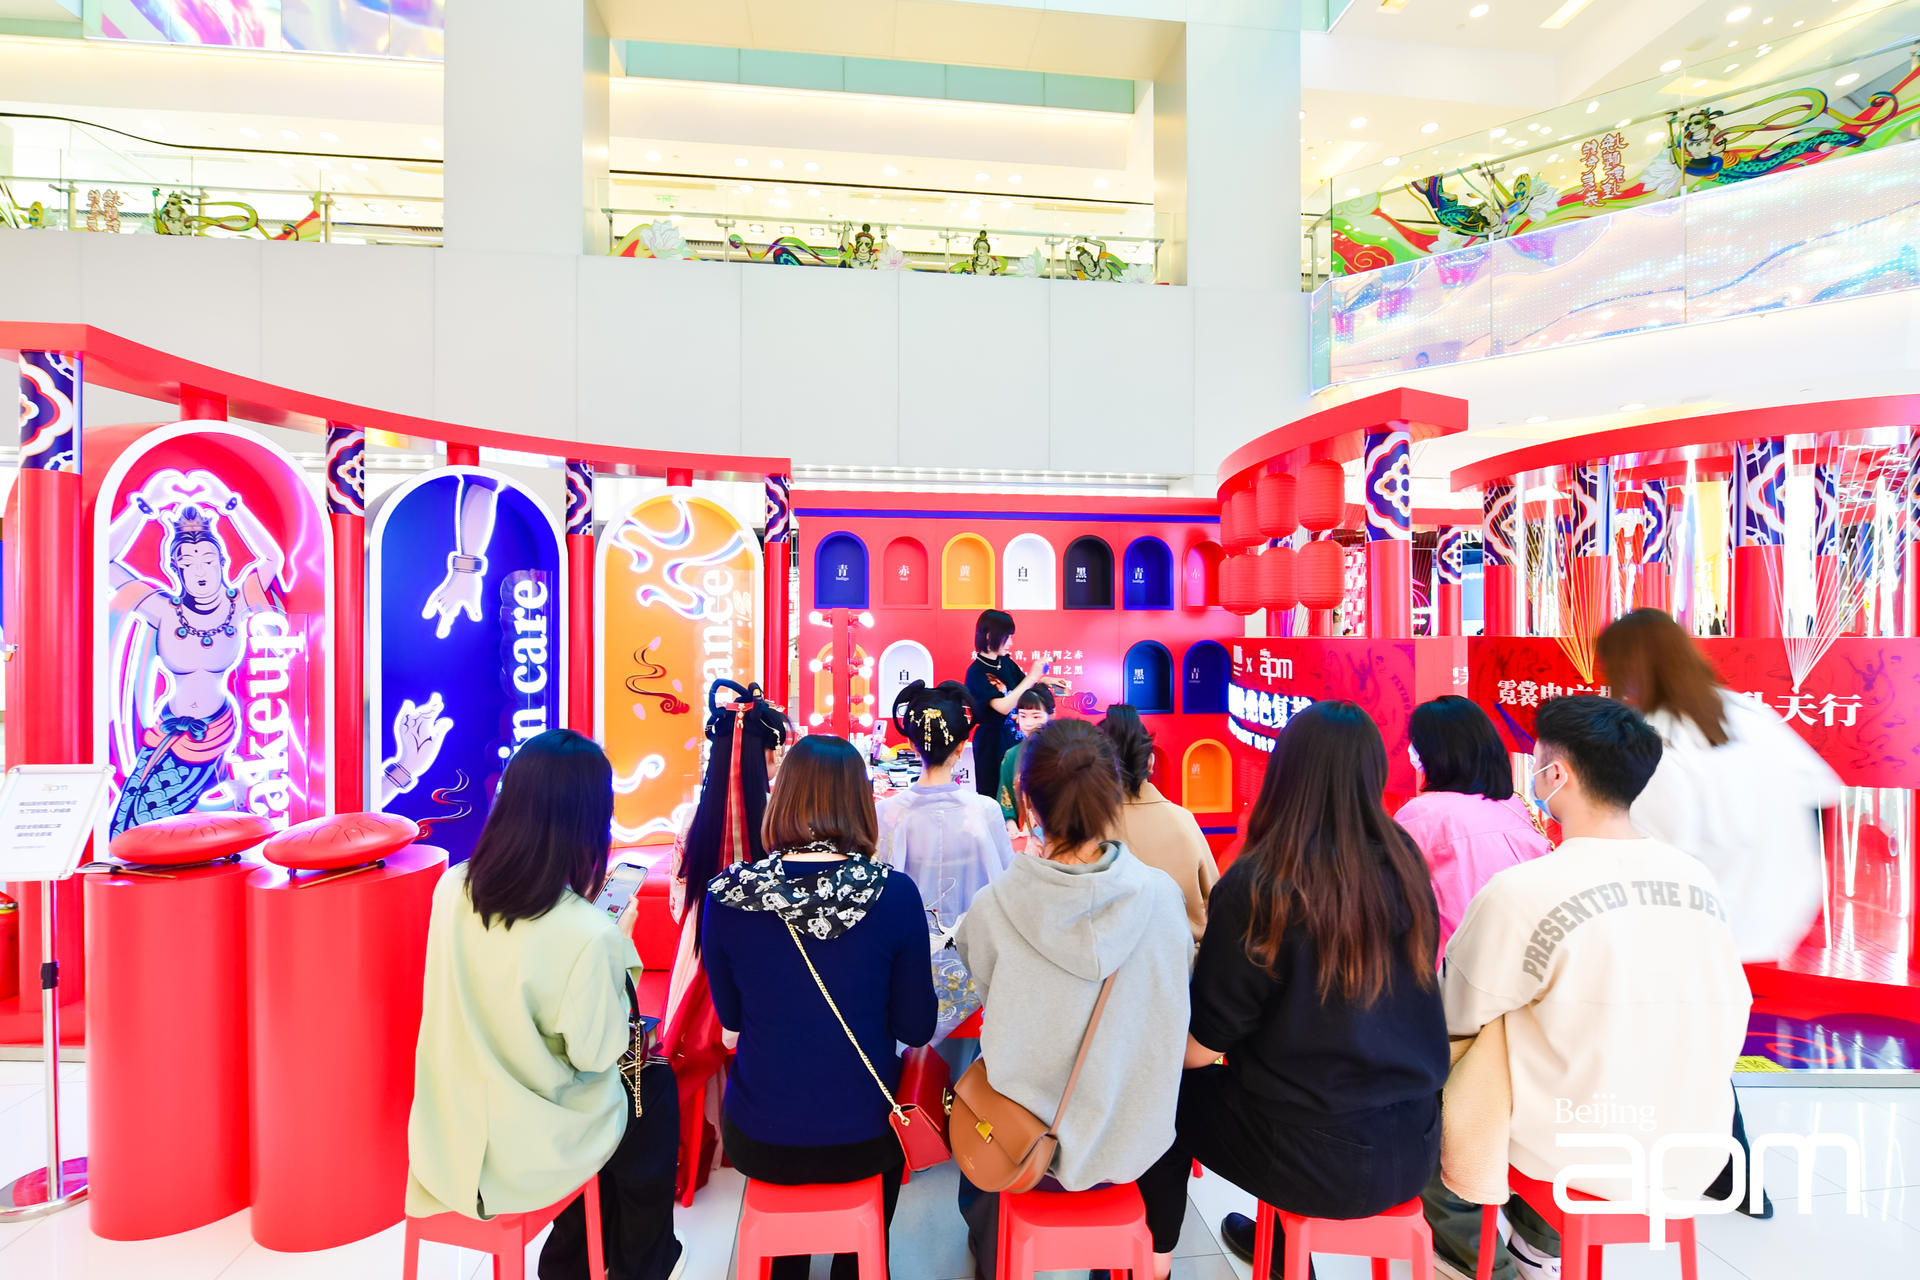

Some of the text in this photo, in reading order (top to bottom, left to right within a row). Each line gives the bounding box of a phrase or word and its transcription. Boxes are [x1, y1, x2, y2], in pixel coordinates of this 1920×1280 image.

[1018, 566, 1028, 578] 白
[1075, 567, 1087, 578] 黑
[512, 578, 548, 695] care
[899, 669, 910, 681] 白
[1133, 668, 1145, 680] 黑
[1259, 657, 1293, 685] apm
[234, 611, 305, 831] akeup
[1522, 882, 1629, 983] PRESENTED
[1631, 880, 1682, 907] THE
